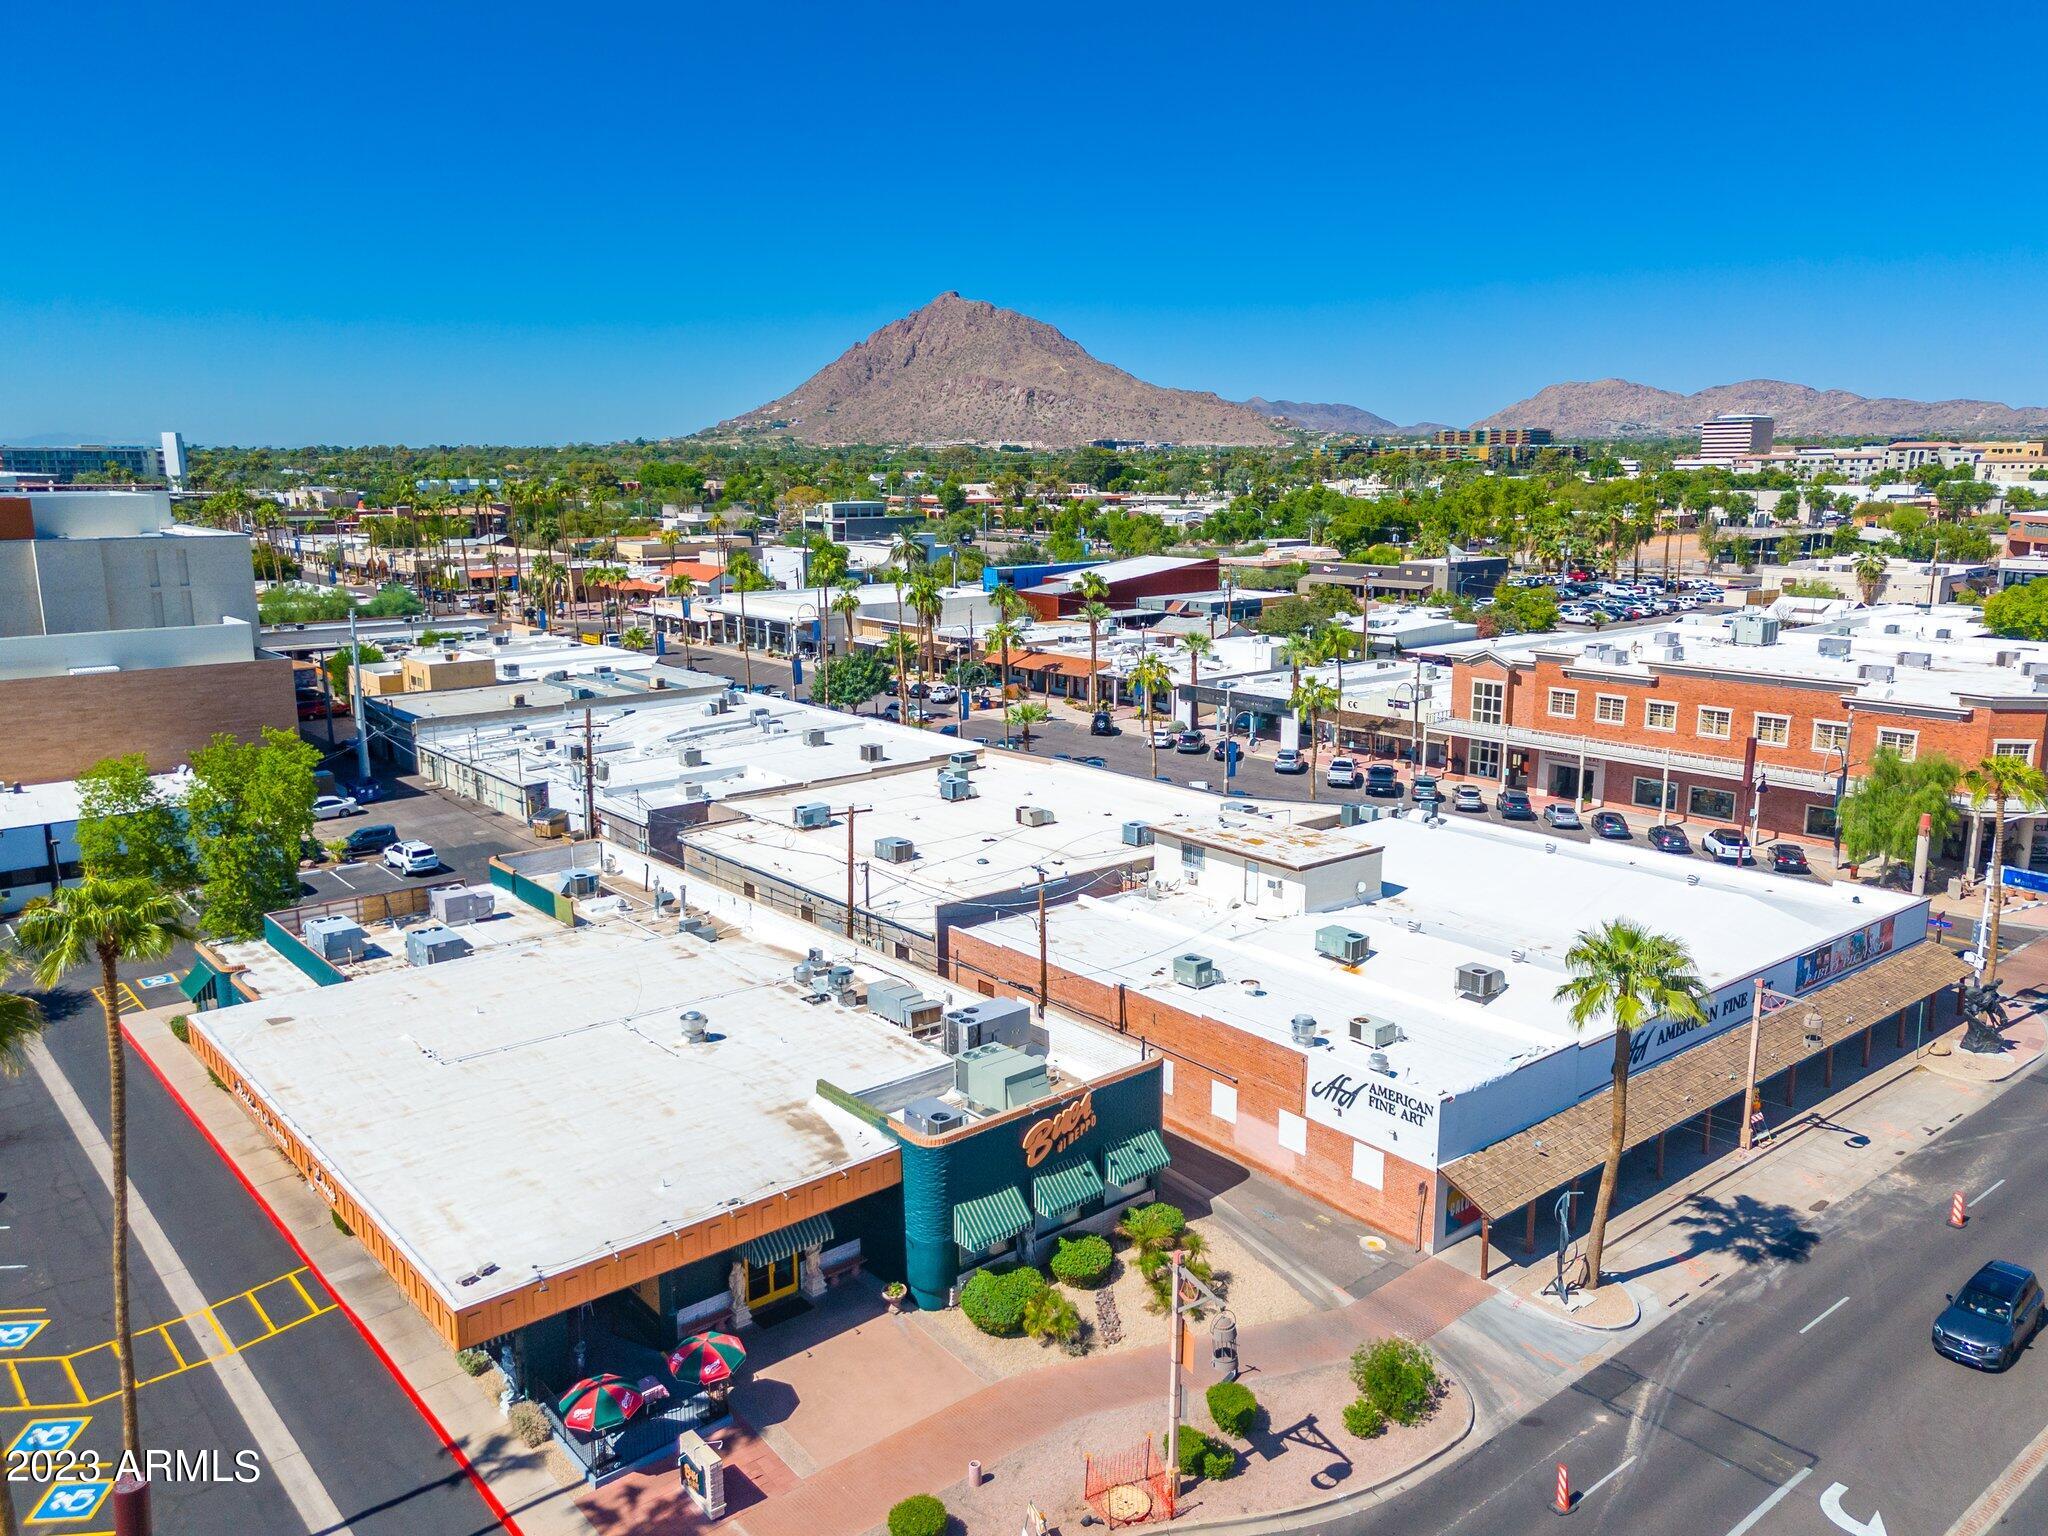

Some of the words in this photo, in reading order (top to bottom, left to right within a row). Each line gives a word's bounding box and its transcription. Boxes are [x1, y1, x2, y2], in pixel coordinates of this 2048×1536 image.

[1722, 992, 1748, 1016] FINE
[1368, 1095, 1396, 1116] FINE
[1400, 1109, 1426, 1127] ART
[1369, 1082, 1434, 1117] AMERICAN
